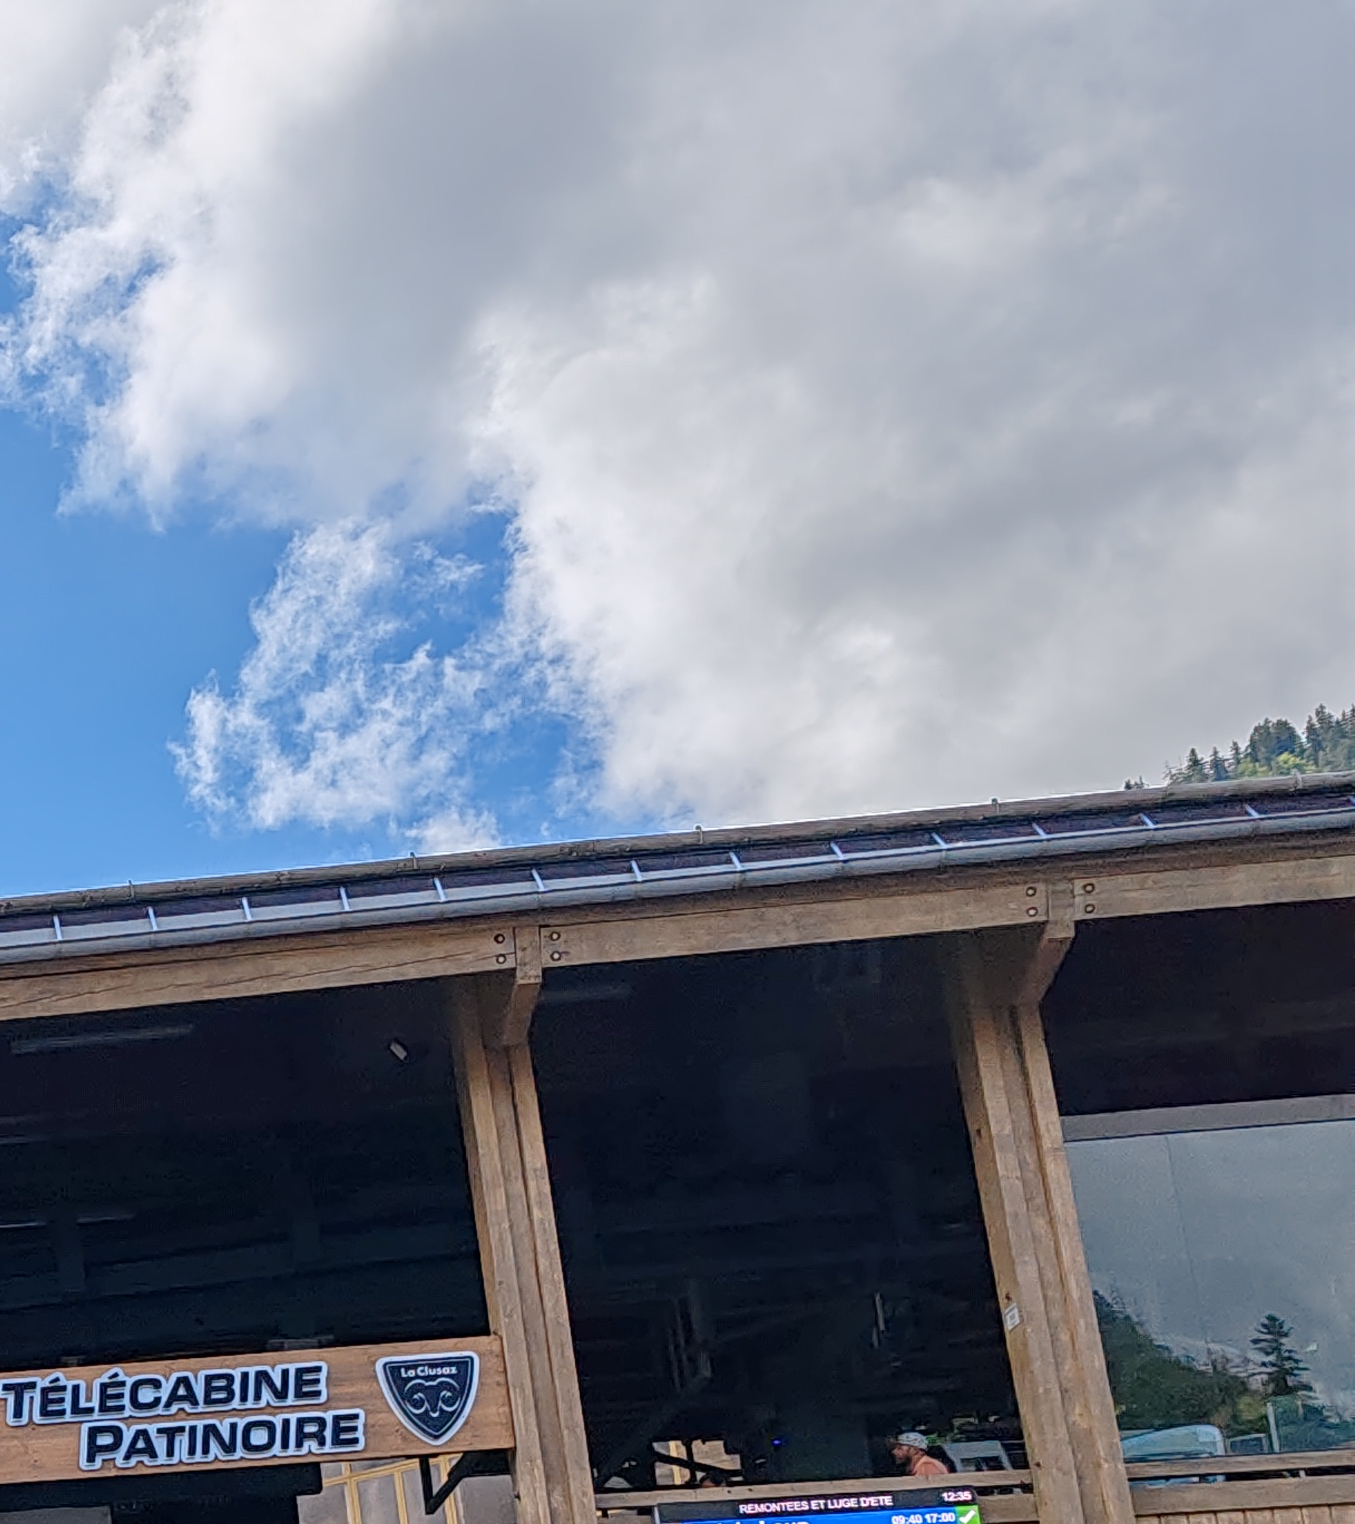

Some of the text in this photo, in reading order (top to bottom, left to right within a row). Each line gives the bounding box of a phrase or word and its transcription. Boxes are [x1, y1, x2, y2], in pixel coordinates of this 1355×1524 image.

[401, 1366, 458, 1378] La Clusaz
[0, 1363, 325, 1421] TÉLÉCABINE
[85, 1412, 362, 1467] PATINOIRE
[942, 1491, 972, 1502] 12:35
[739, 1501, 809, 1515] REMONTEES
[811, 1500, 826, 1511] ET
[828, 1498, 858, 1509] LUGE
[891, 1514, 923, 1524] 09:40
[924, 1512, 956, 1523] 17:00
